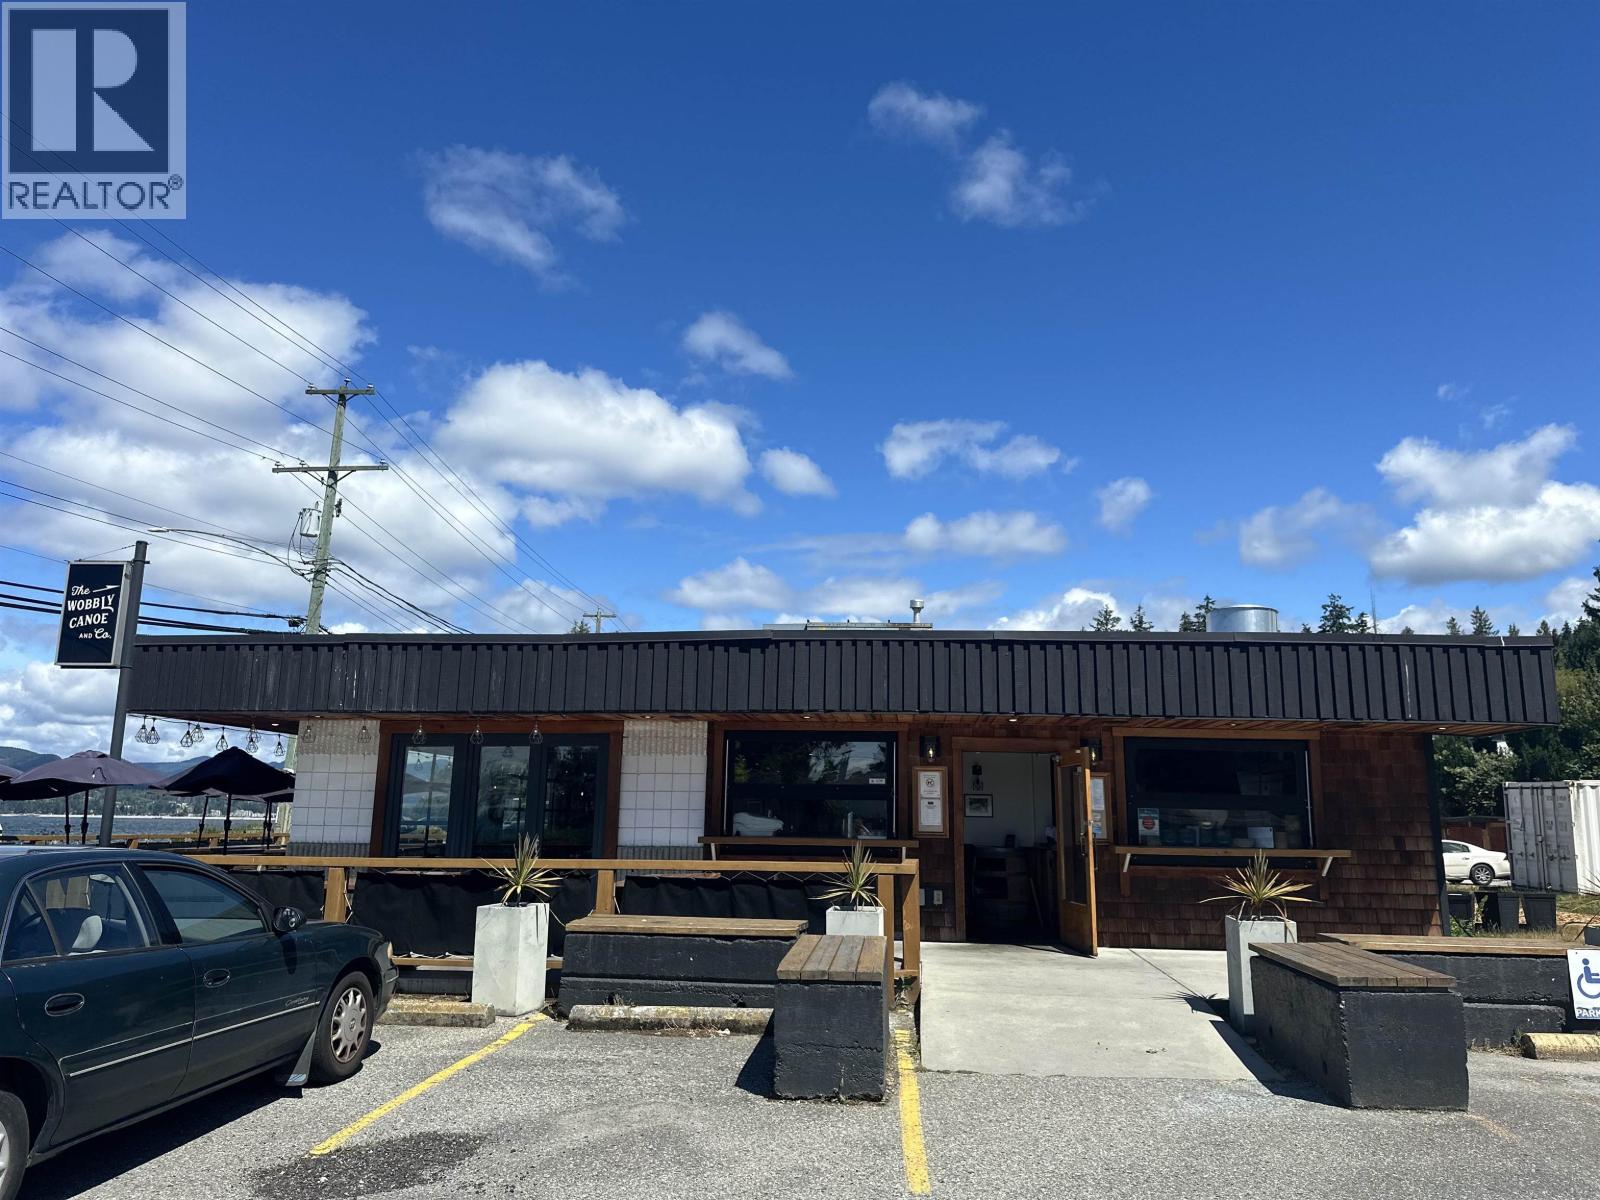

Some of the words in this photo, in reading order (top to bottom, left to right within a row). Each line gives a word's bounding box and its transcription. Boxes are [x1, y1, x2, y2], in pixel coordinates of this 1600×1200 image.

[71, 584, 90, 596] The
[67, 594, 115, 612] WOBBLY
[69, 612, 109, 629] CANOE
[94, 627, 112, 639] Co.
